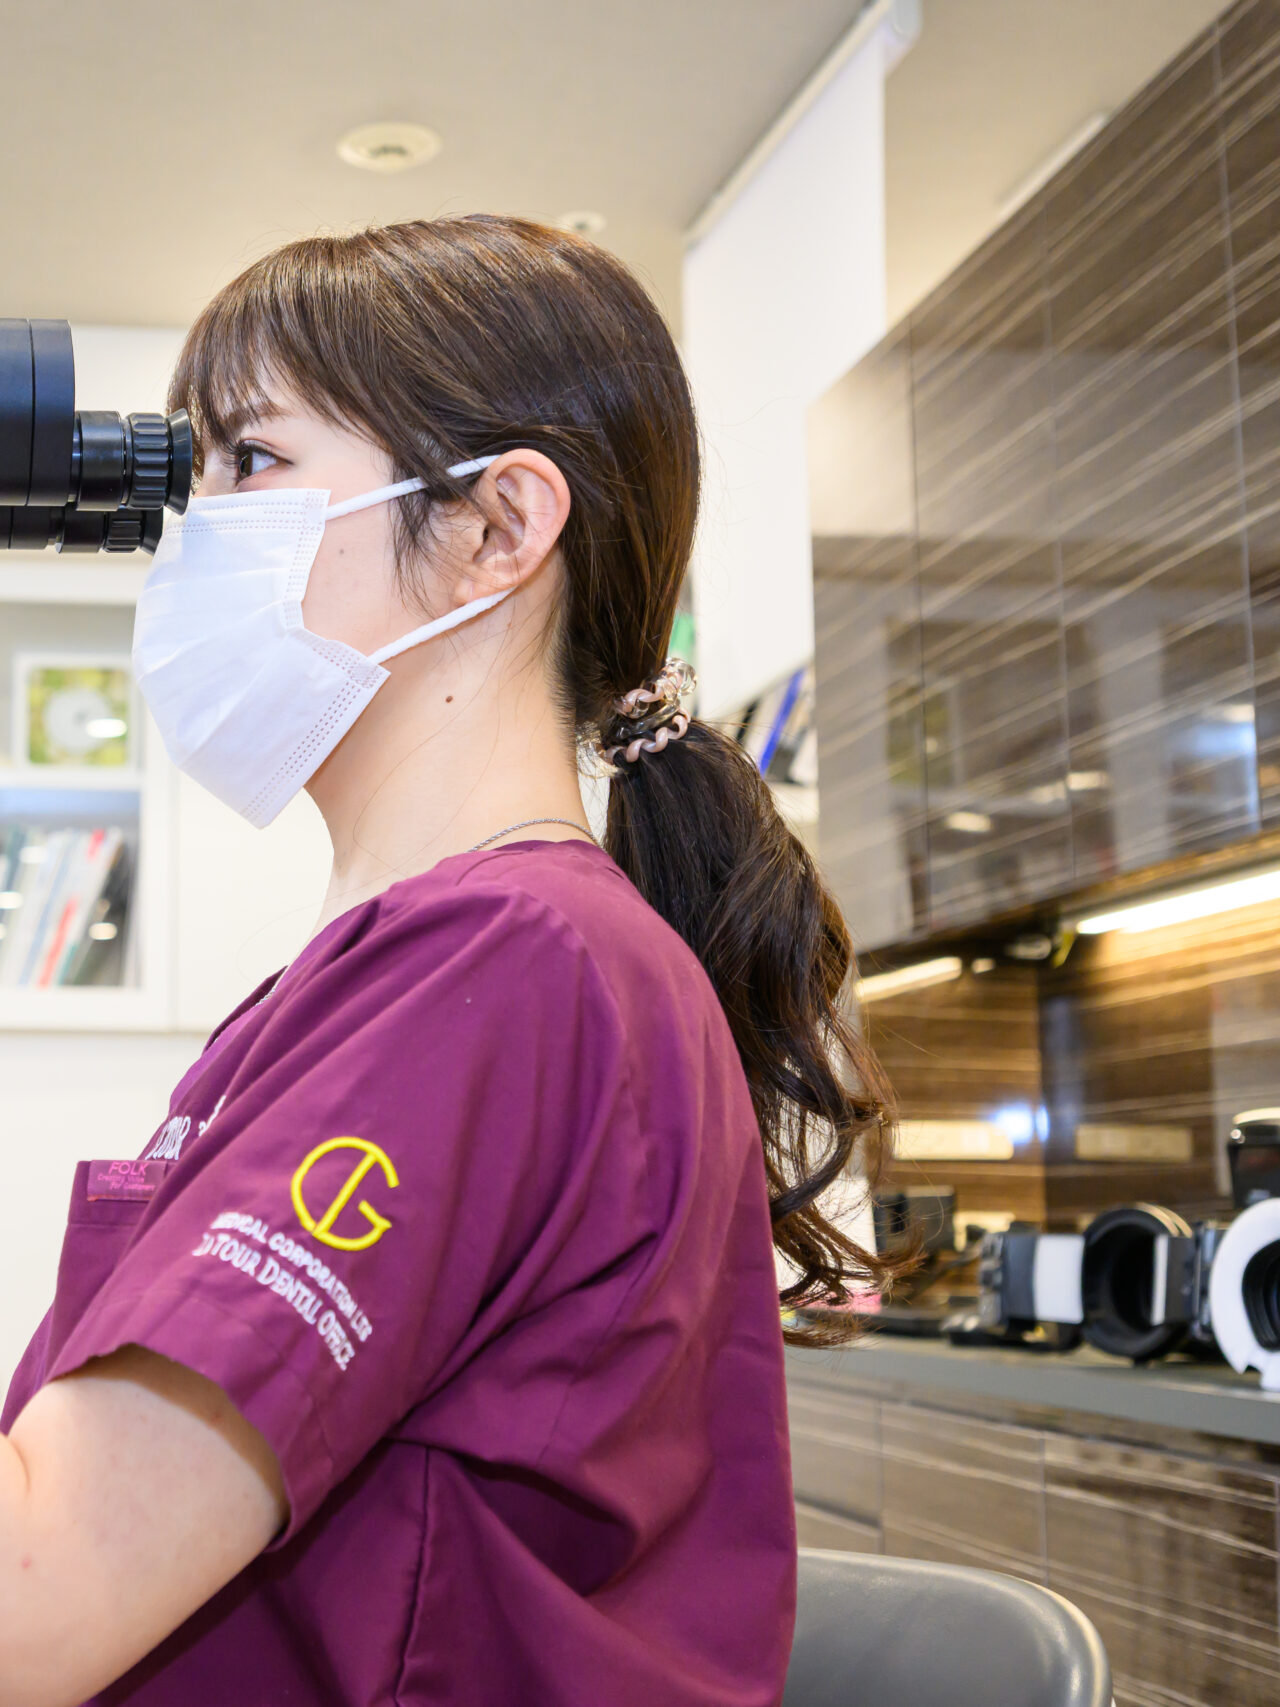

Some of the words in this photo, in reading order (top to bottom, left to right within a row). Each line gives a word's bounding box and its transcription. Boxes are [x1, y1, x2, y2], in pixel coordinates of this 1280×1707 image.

[108, 1161, 150, 1176] FOLK
[256, 1255, 323, 1325] DENTAL
[317, 1310, 356, 1371] OFFICE
[269, 1232, 358, 1319] CORPORATION
